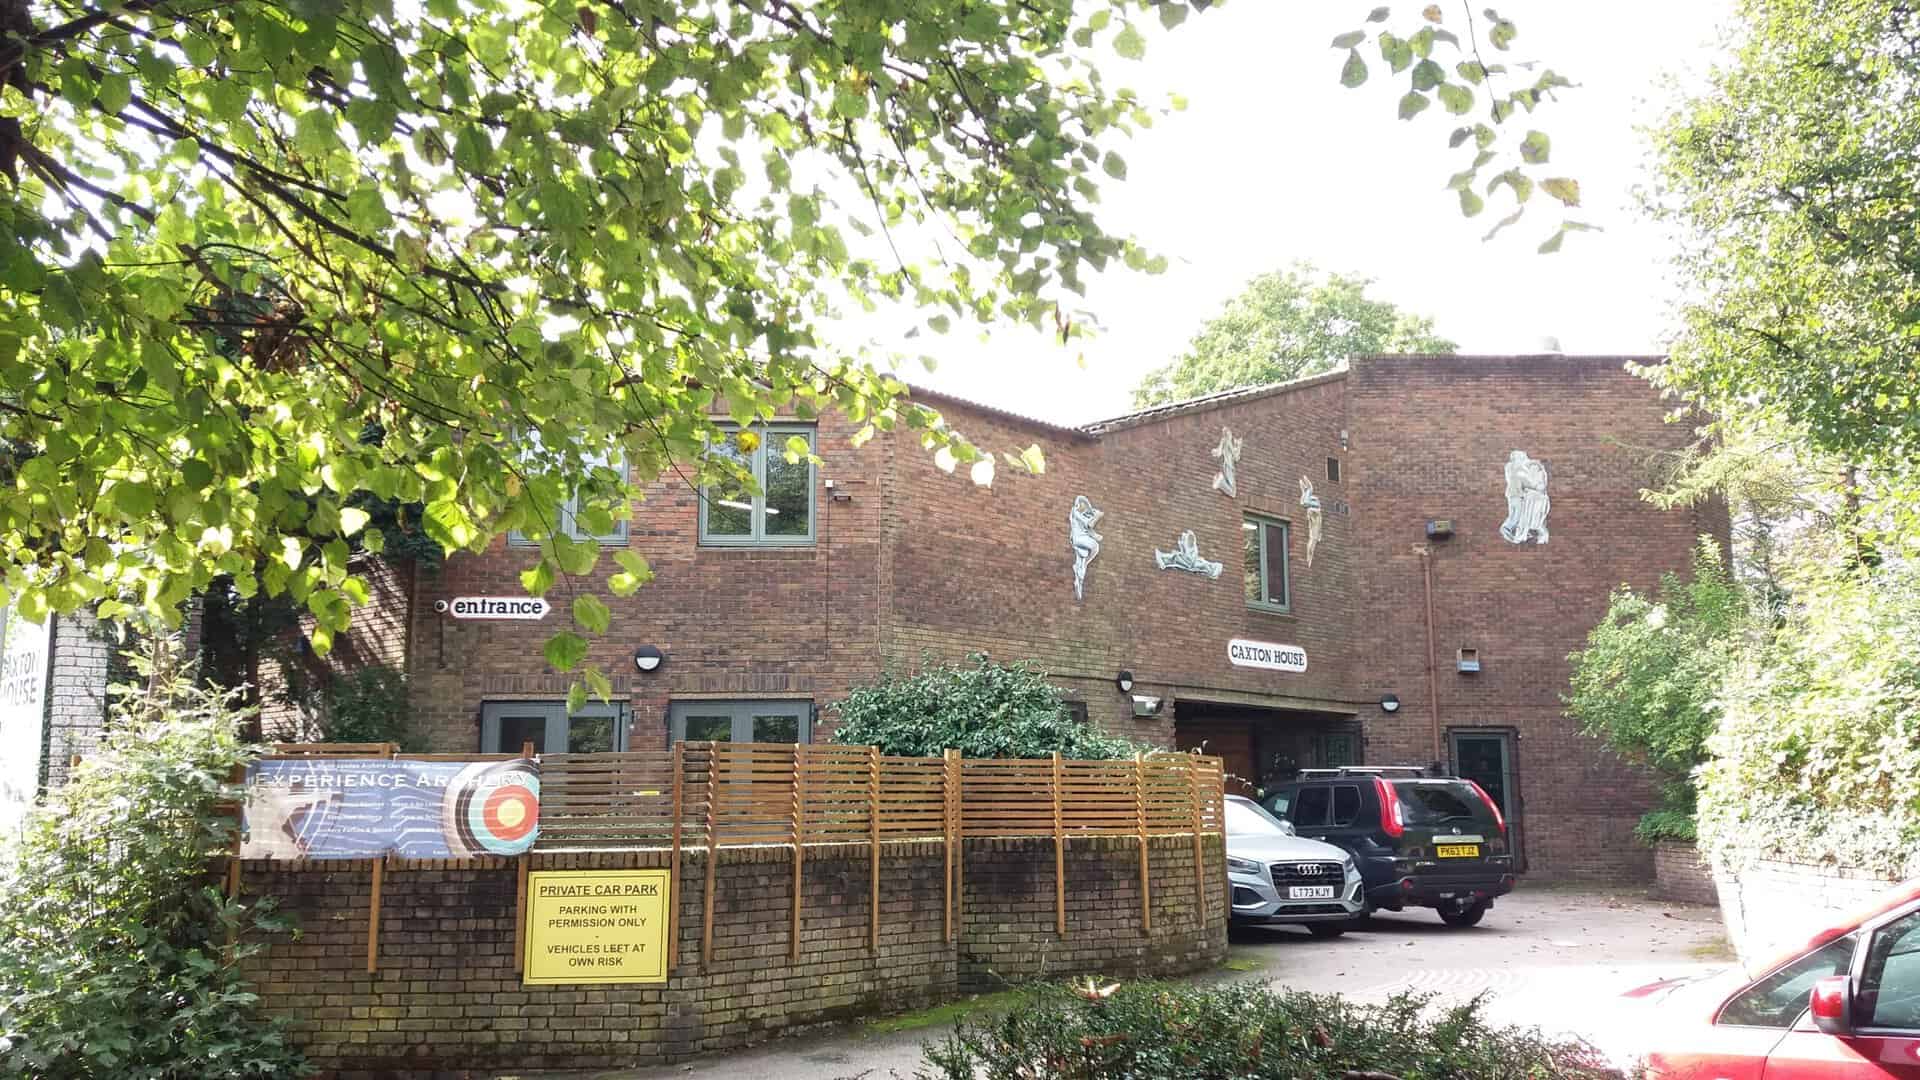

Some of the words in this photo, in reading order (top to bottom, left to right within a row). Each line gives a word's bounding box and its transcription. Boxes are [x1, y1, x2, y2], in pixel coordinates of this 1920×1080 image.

[454, 598, 543, 615] entrance
[1231, 645, 1271, 662] CAXTON
[1273, 650, 1305, 666] HOUSE
[2, 650, 41, 677] AXTON
[255, 772, 407, 788] EXPERIENCE
[540, 885, 591, 896] PRIVATE
[594, 884, 621, 895] CAR
[624, 884, 658, 895] PARK
[559, 905, 607, 915] PARKING
[610, 905, 637, 914] WITH
[548, 918, 615, 928] PERMISSION
[618, 918, 647, 927] ONLY
[547, 944, 600, 954] VEHICLES
[632, 944, 646, 953] AT
[568, 957, 595, 967] OWN
[598, 957, 623, 966] RISK
